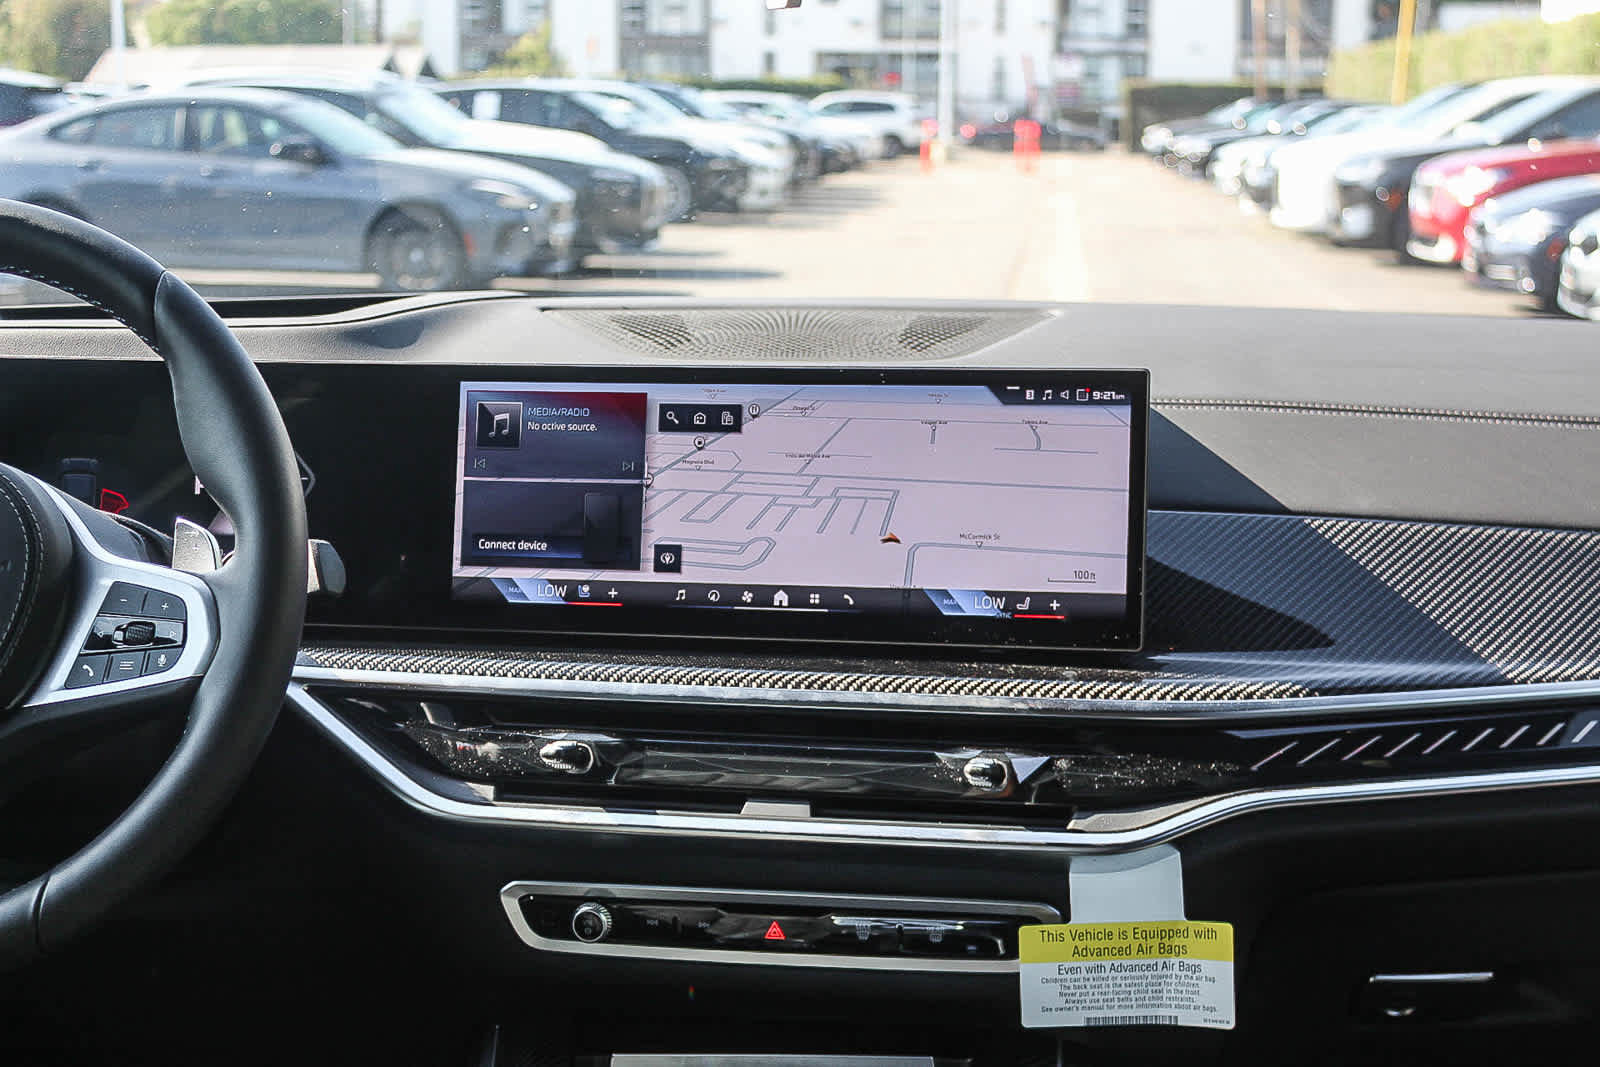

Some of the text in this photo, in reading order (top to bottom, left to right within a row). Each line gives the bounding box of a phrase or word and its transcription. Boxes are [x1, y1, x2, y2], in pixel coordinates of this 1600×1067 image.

[528, 407, 590, 417] MEDIA/RADIO
[528, 421, 598, 432] No active source.
[959, 533, 992, 541] McCormick
[478, 538, 548, 551] Connect device
[537, 583, 568, 598] LOW
[974, 595, 1006, 609] LOW
[1040, 926, 1217, 943] This Vehicle is Equipped with
[1071, 942, 1188, 958] Advanced Air Bags
[1057, 960, 1202, 976] Even with Advanced Air Bags
[1041, 976, 1068, 984] Children
[1119, 974, 1149, 982] seriously
[1150, 973, 1173, 981] injured
[1174, 972, 1182, 981] by
[1144, 981, 1162, 989] place
